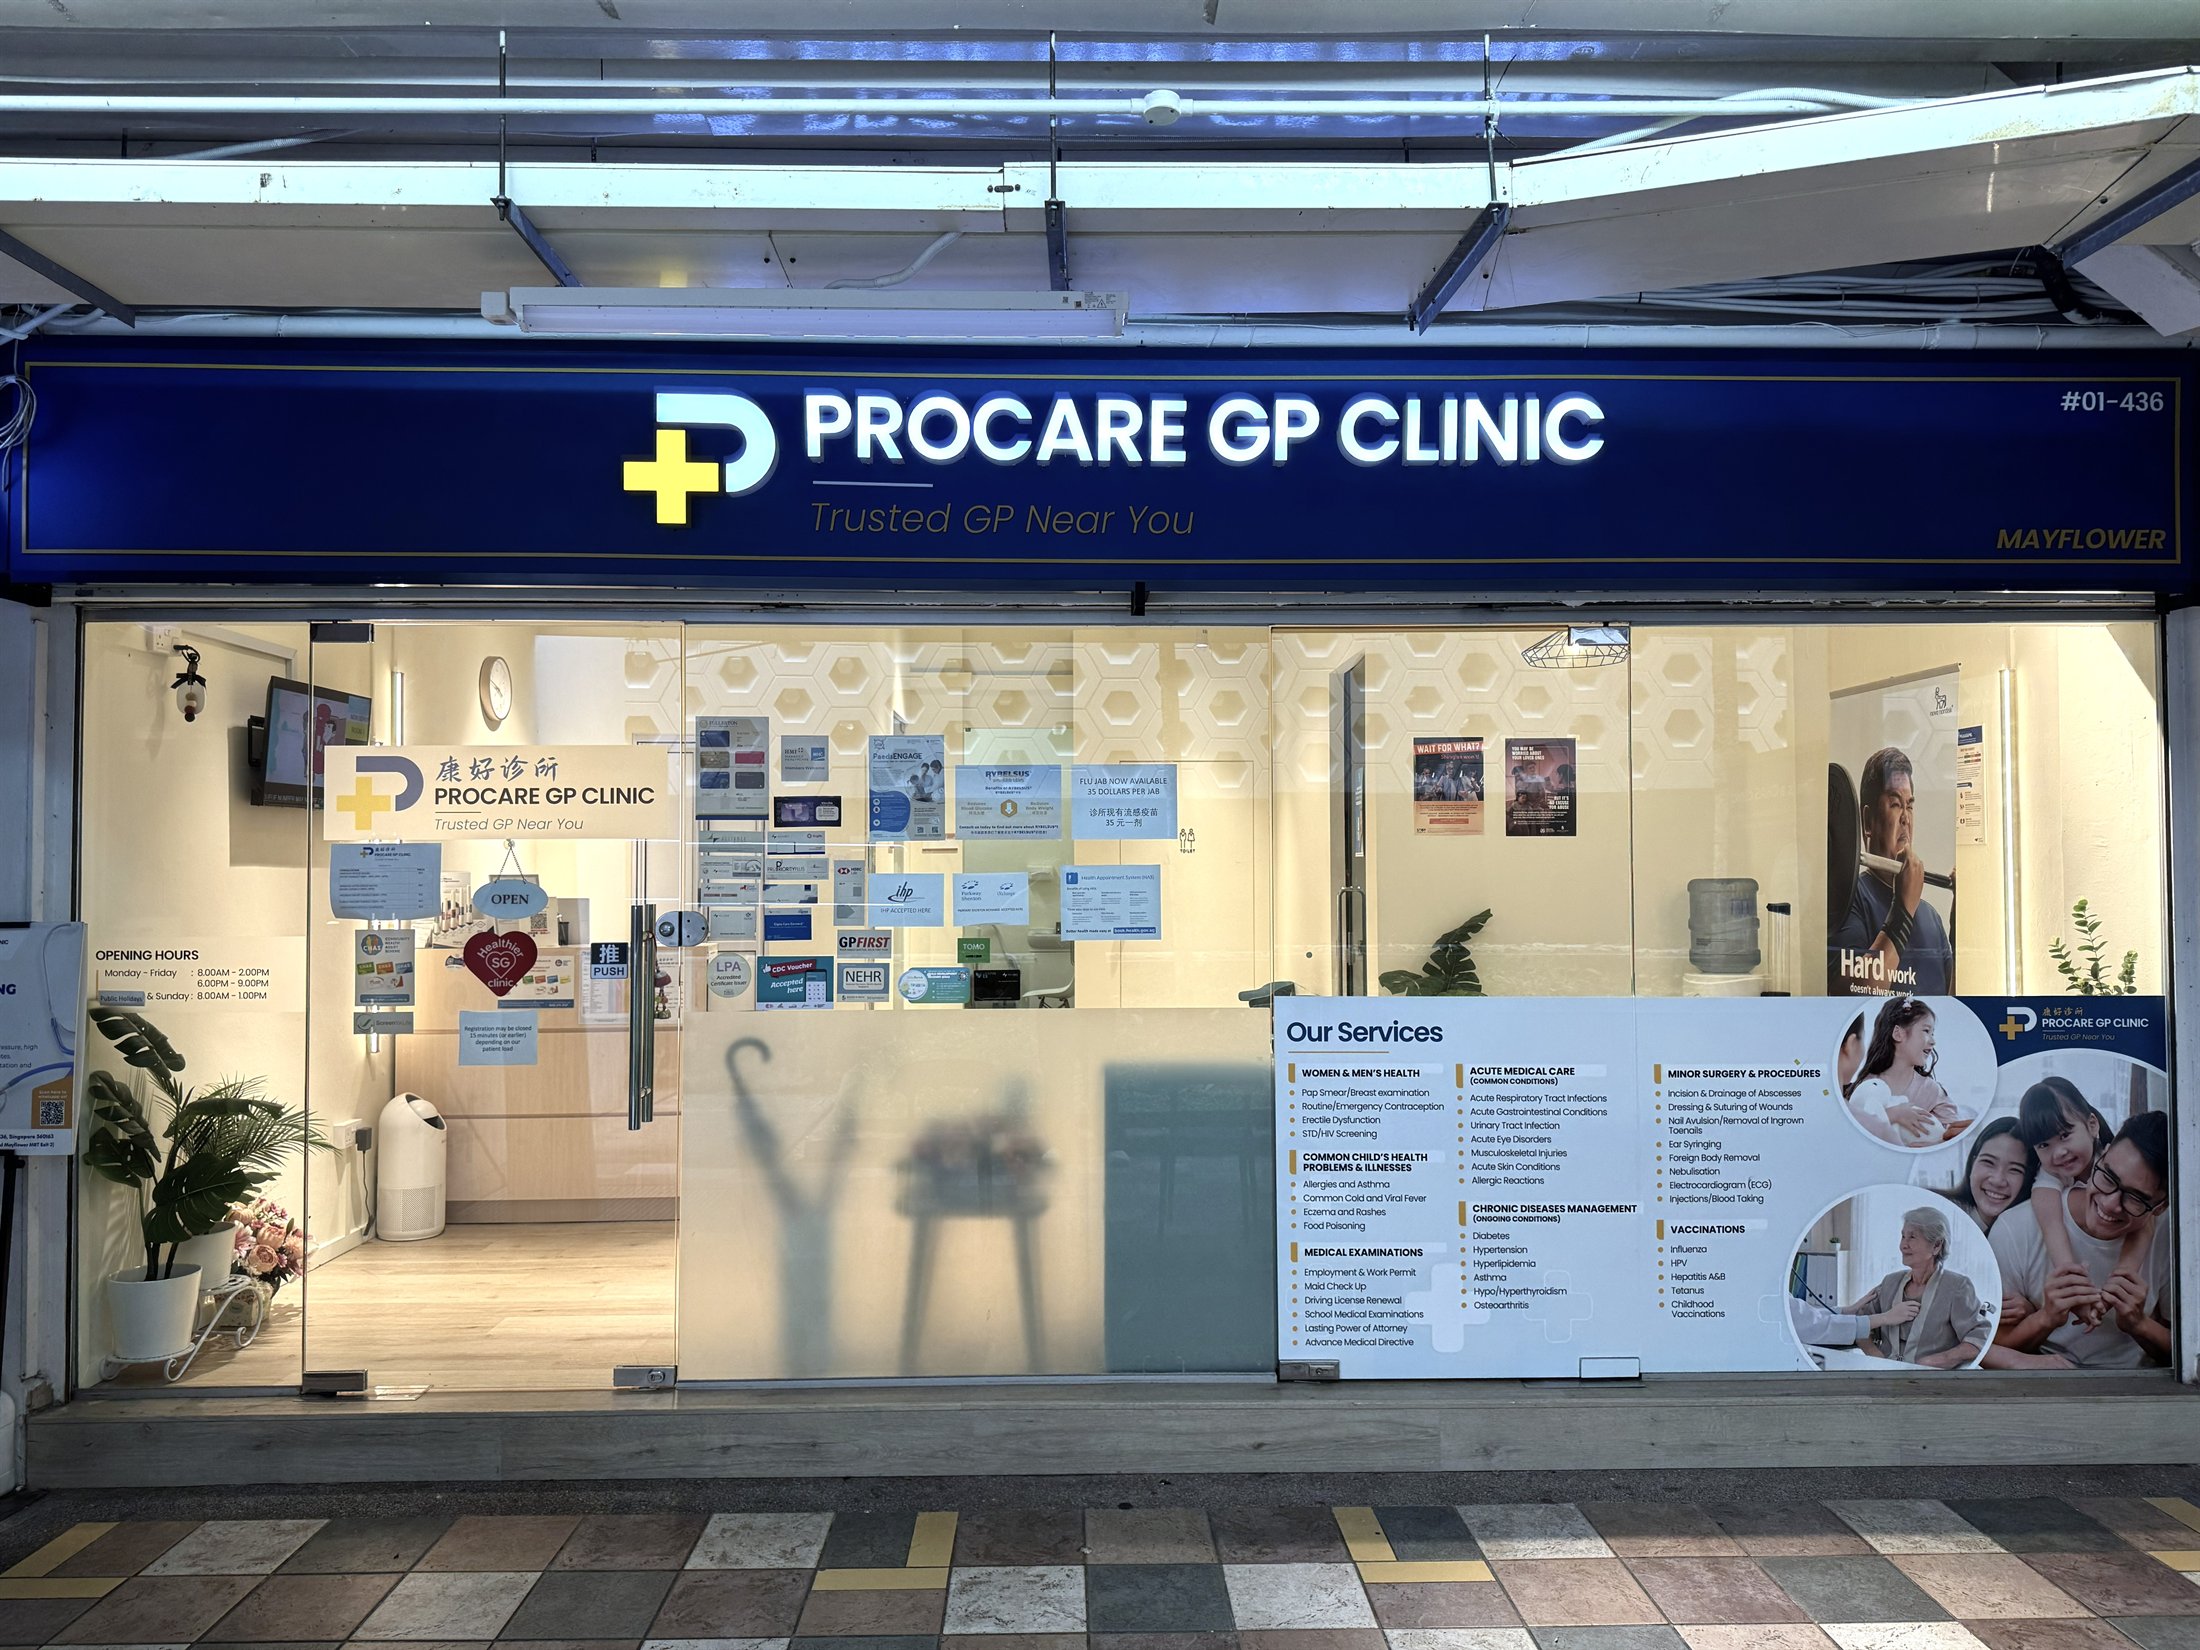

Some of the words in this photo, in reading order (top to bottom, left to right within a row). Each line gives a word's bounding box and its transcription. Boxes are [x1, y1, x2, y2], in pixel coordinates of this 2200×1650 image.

[2060, 391, 2164, 412] #01-436
[805, 393, 1187, 462] PROCARE
[1209, 398, 1320, 462] GP
[1339, 395, 1605, 463] CLINIC
[811, 503, 951, 532] Trusted
[964, 505, 1014, 533] GP
[1026, 505, 1115, 534] Near
[1129, 506, 1194, 534] You
[1996, 528, 2166, 549] MAYFLOWER
[1417, 745, 1436, 754] WAIT
[1438, 744, 1452, 753] FOR
[1454, 742, 1480, 752] WHAT?
[436, 755, 559, 782] 康好诊所
[1130, 777, 1168, 785] AVAILABLE
[435, 787, 540, 805] PROCARE
[545, 787, 577, 805] GP
[582, 787, 655, 804] CLINIC
[1089, 807, 1158, 818] 诊所现有流感疫苗
[435, 818, 489, 830] Trusted
[493, 818, 514, 830] GP
[517, 818, 553, 830] Near
[557, 818, 584, 830] You
[490, 894, 529, 905] OPEN
[838, 936, 891, 948] GPFIRST
[962, 943, 985, 951] TOMO
[477, 939, 524, 959] Healthier
[599, 944, 620, 964] 推
[95, 950, 152, 961] OPENING
[155, 950, 199, 961] HOURS
[491, 956, 511, 969] SG
[716, 961, 742, 972] LPA
[772, 965, 786, 973] CDC
[787, 962, 814, 971] Voucher
[1841, 948, 1885, 981] Hard
[104, 968, 141, 979] Monday
[150, 968, 177, 979] Friday
[197, 968, 230, 977] 8.00AM
[238, 968, 270, 977] 2.00PM
[593, 967, 625, 976] PUSH
[845, 970, 882, 982] NEHR
[1887, 967, 1917, 985] work
[197, 979, 229, 988] 6.00PM
[237, 979, 269, 988] 9.00PM
[488, 978, 513, 988] clinic
[770, 978, 804, 988] Accepted
[1850, 982, 1871, 995] doesn't
[787, 986, 804, 995] here
[119, 995, 142, 1003] Holidays
[147, 992, 154, 1000] &
[155, 991, 189, 1002] Sunday
[197, 991, 230, 1000] 8.00AM
[238, 991, 267, 1000] 1.00PM
[2042, 1018, 2094, 1028] PROCARE
[2095, 1018, 2111, 1027] GP
[2113, 1018, 2149, 1027] CLINIC
[464, 1025, 495, 1033] Registration
[496, 1026, 507, 1034] may
[1287, 1022, 1333, 1042] Our
[1338, 1020, 1443, 1042] Services
[507, 1032, 527, 1040] earlier)
[2042, 1032, 2069, 1041] Trusted
[2070, 1033, 2081, 1041] GP
[2082, 1033, 2100, 1041] Near
[2101, 1033, 2115, 1041] You
[475, 1039, 503, 1047] depending
[482, 1045, 501, 1053] patient
[1302, 1069, 1340, 1077] WOMEN
[1342, 1069, 1350, 1077] &
[1352, 1069, 1382, 1077] MEN'S
[1383, 1069, 1420, 1077] HEALTH
[1470, 1067, 1502, 1075] ACUTE
[1504, 1067, 1547, 1075] MEDICAL
[1548, 1067, 1575, 1076] CARE
[1668, 1070, 1701, 1078] MINOR
[1702, 1070, 1747, 1078] SURGERY
[1748, 1070, 1756, 1078] &
[1758, 1069, 1821, 1078] PROCEDURES
[1470, 1077, 1509, 1086] (COMMON
[1509, 1077, 1558, 1086] CONDITIONS)
[1302, 1115, 1331, 1124] Erectile
[1332, 1115, 1381, 1126] Dysfunction
[1303, 1153, 1350, 1161] COMMON
[1351, 1153, 1389, 1161] CHILD'S
[1391, 1153, 1428, 1162] HEALTH
[1303, 1163, 1354, 1172] PROBLEMS
[1355, 1163, 1363, 1172] &
[1365, 1163, 1412, 1172] ILLNESSES
[1669, 1181, 1746, 1191] Electrocardiogram
[1747, 1179, 1772, 1190] (ECG)
[1472, 1204, 1518, 1213] CHRONIC
[1520, 1204, 1566, 1213] DISEASES
[1567, 1204, 1637, 1213] MANAGEMENT
[1473, 1214, 1511, 1224] (ONGOING
[1512, 1214, 1561, 1224] CONDITIONS)
[1670, 1225, 1745, 1234] VACCINATIONS
[1473, 1232, 1510, 1240] Diabetes
[1304, 1248, 1347, 1257] MEDICAL
[1349, 1248, 1423, 1257] EXAMINATIONS
[1473, 1245, 1528, 1256] Hypertension
[1670, 1245, 1707, 1253] Influenza
[1473, 1259, 1536, 1270] Hyperlipidemia
[1670, 1259, 1688, 1267] HPV
[1671, 1272, 1707, 1283] Hepatitis
[1708, 1272, 1726, 1281] A&B
[1473, 1285, 1567, 1298] Hypo/Hyperthyroidism
[1474, 1301, 1529, 1309] Osteoarthritis
